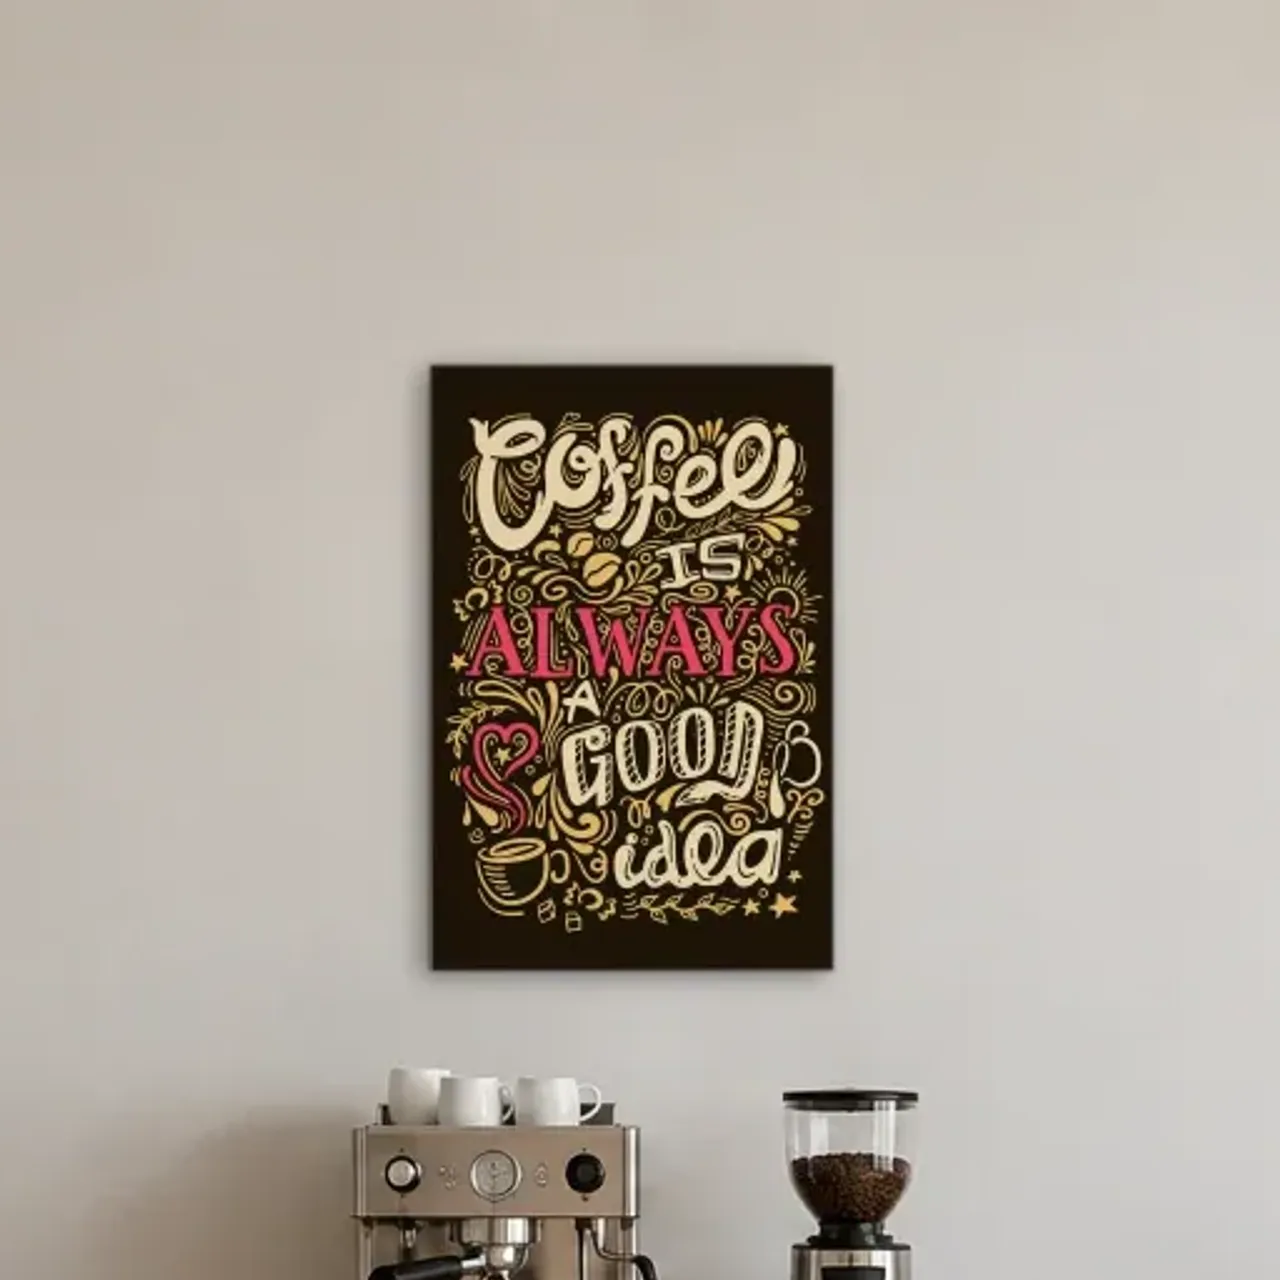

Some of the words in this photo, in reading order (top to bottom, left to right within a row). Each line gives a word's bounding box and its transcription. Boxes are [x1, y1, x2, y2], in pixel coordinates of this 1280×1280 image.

[469, 416, 795, 550] Coffee
[658, 533, 745, 588] IS
[464, 604, 796, 678] ALWAYS
[562, 680, 601, 724] A
[561, 701, 764, 807] GOOD
[615, 820, 783, 889] idea
